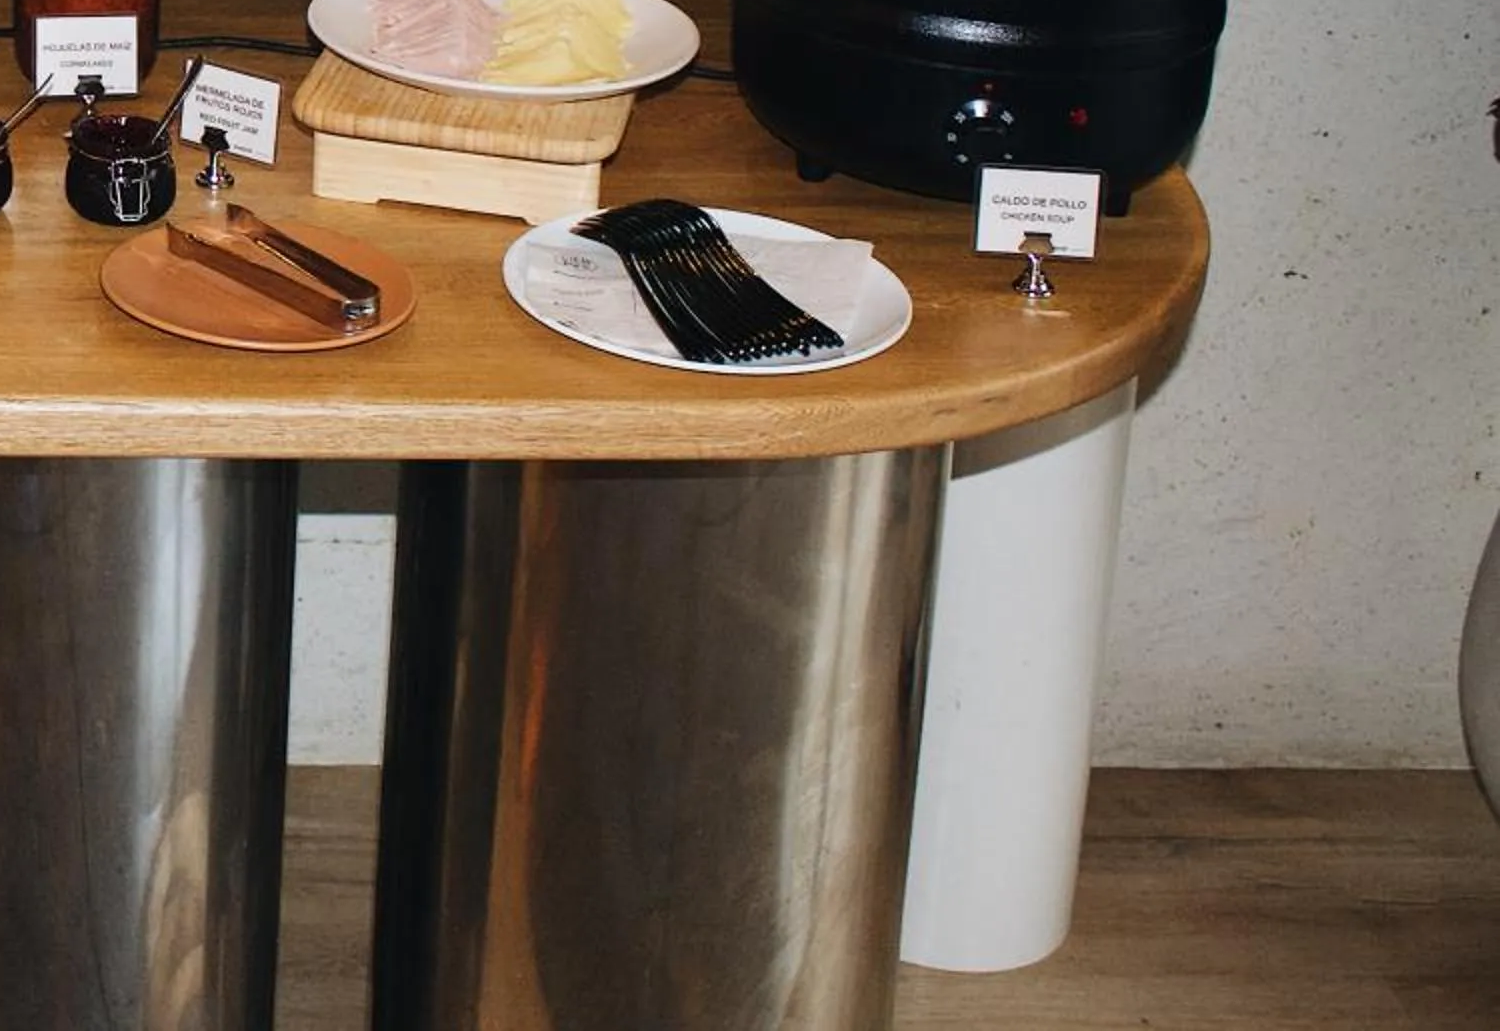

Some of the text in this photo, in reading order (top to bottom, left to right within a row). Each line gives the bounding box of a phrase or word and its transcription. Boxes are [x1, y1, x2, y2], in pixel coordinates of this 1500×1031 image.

[992, 195, 1087, 210] CALDO DE POLLO
[1001, 211, 1045, 222] CHICKEN
